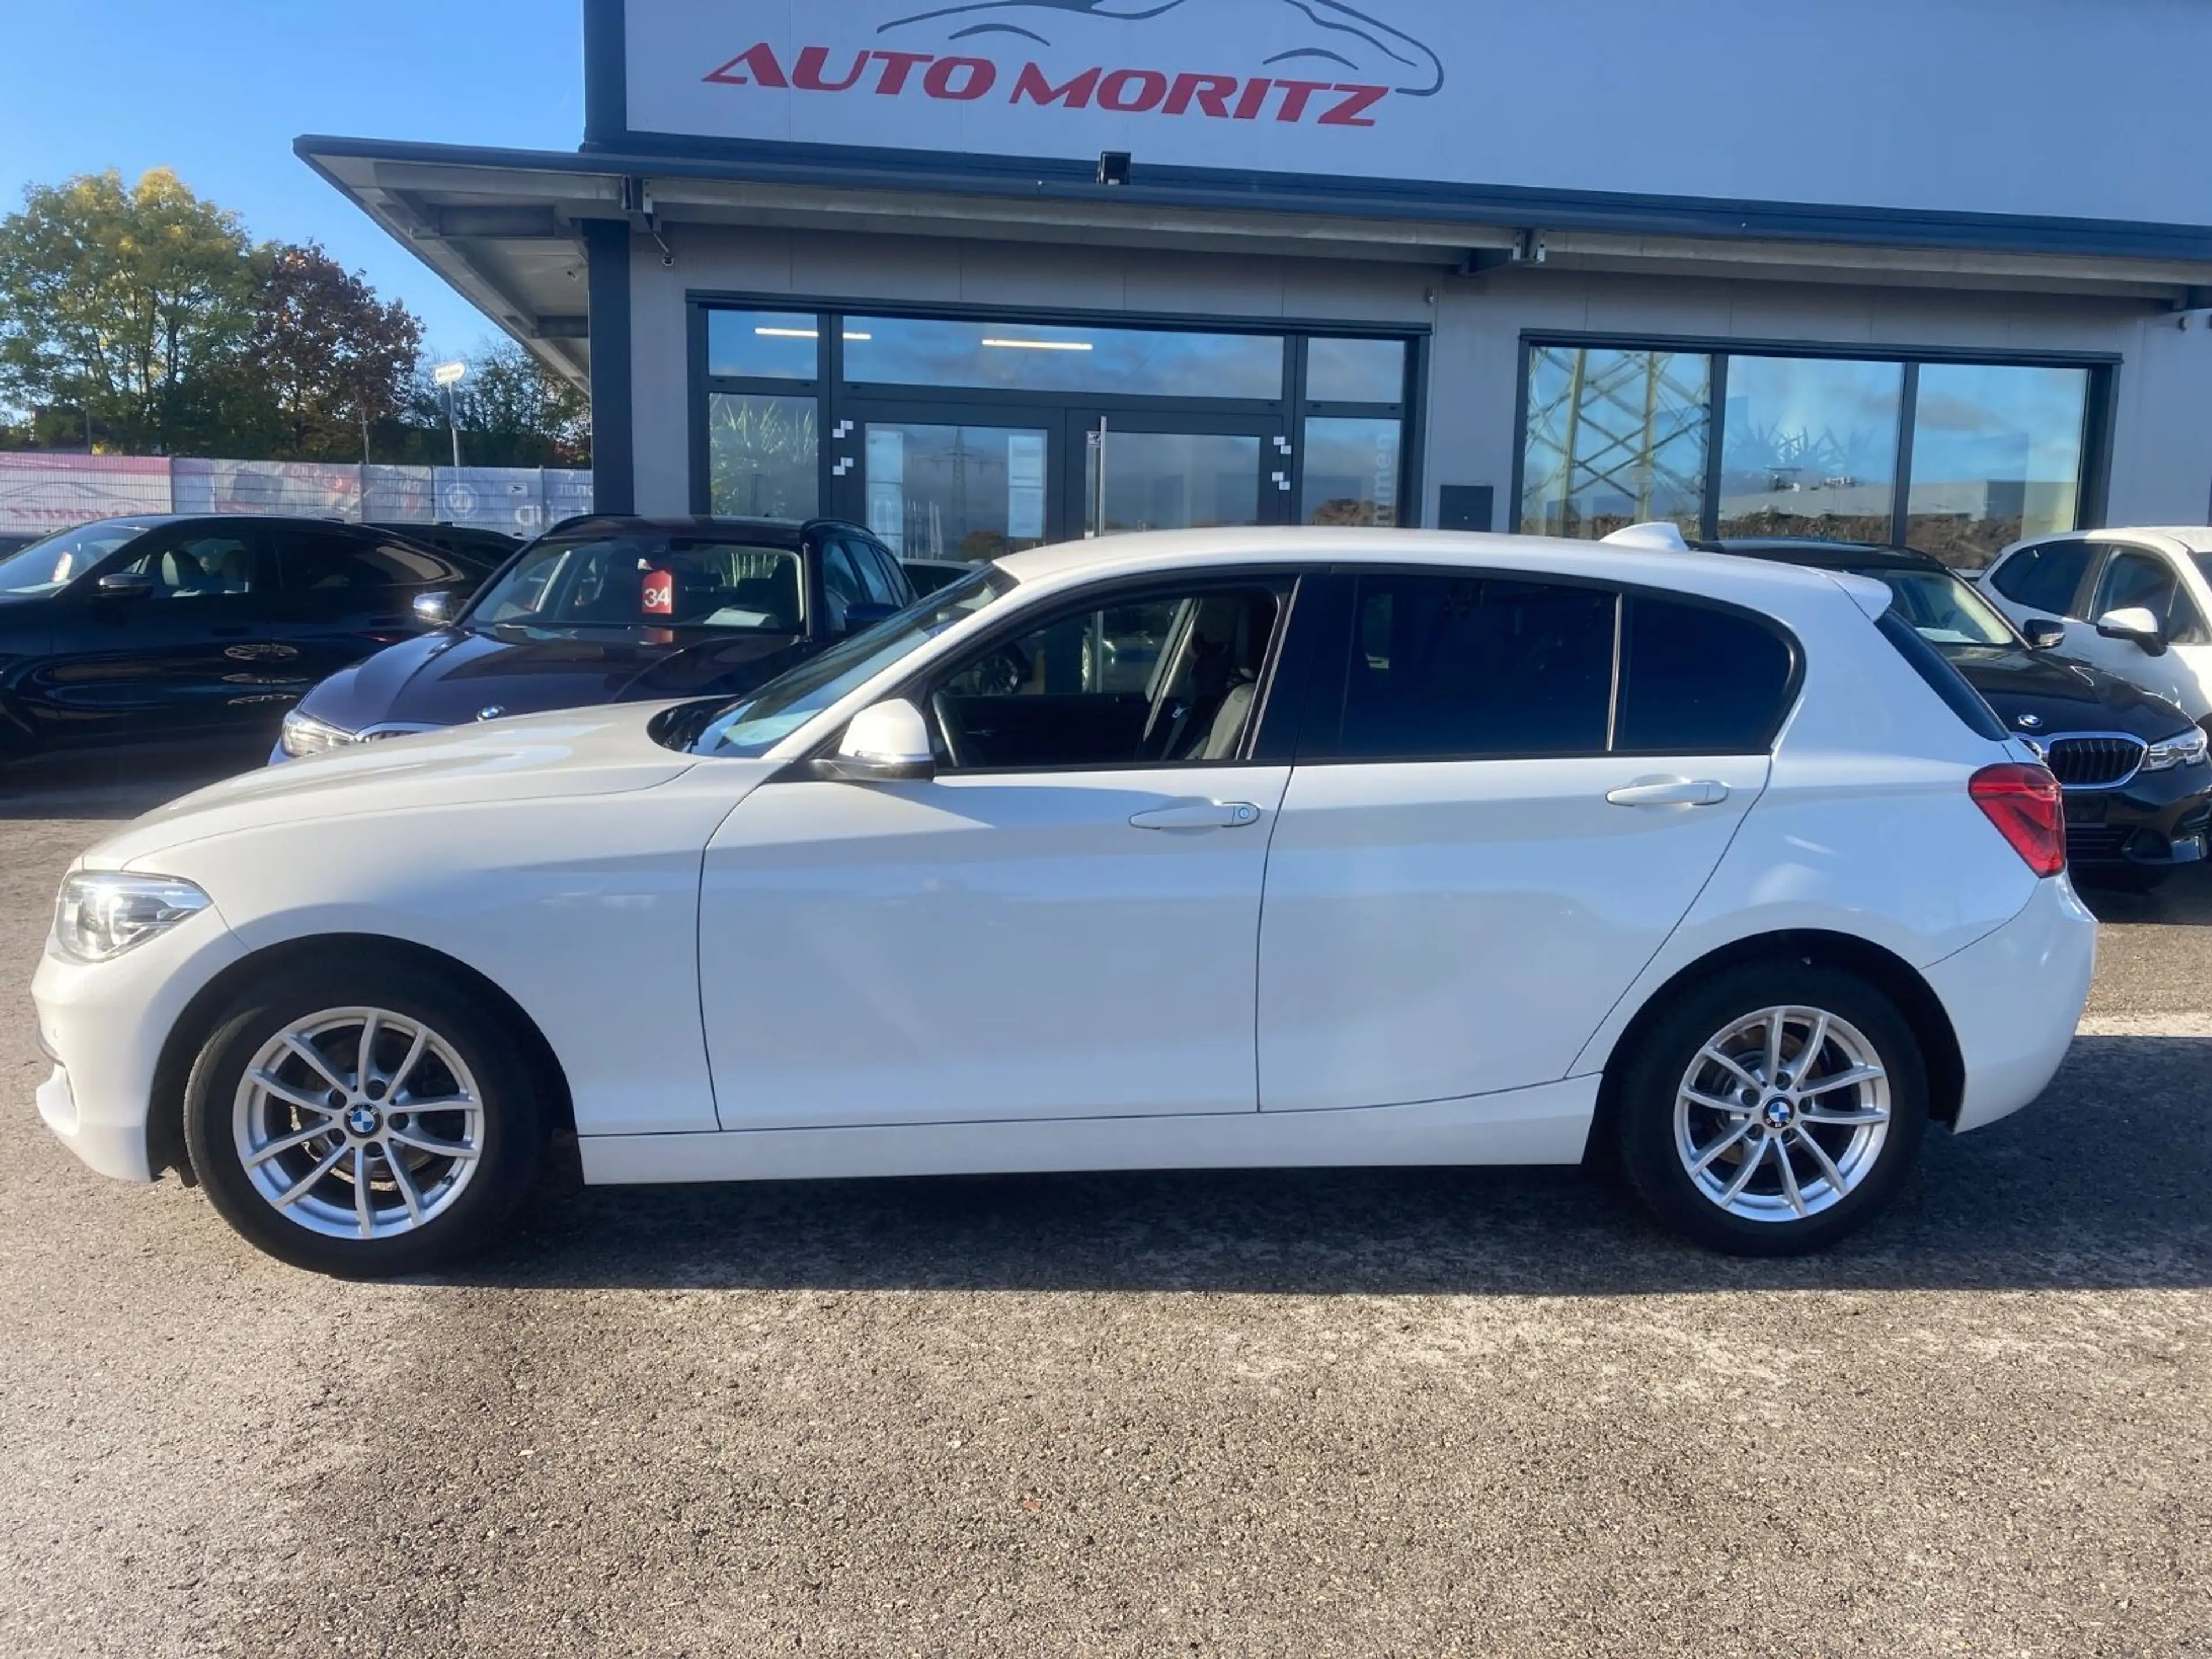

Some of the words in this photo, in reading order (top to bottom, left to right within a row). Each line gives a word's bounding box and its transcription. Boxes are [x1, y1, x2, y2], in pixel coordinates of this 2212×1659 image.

[702, 42, 997, 100] AUTO
[1009, 61, 1389, 126] MORITZ
[644, 586, 671, 608] 34
